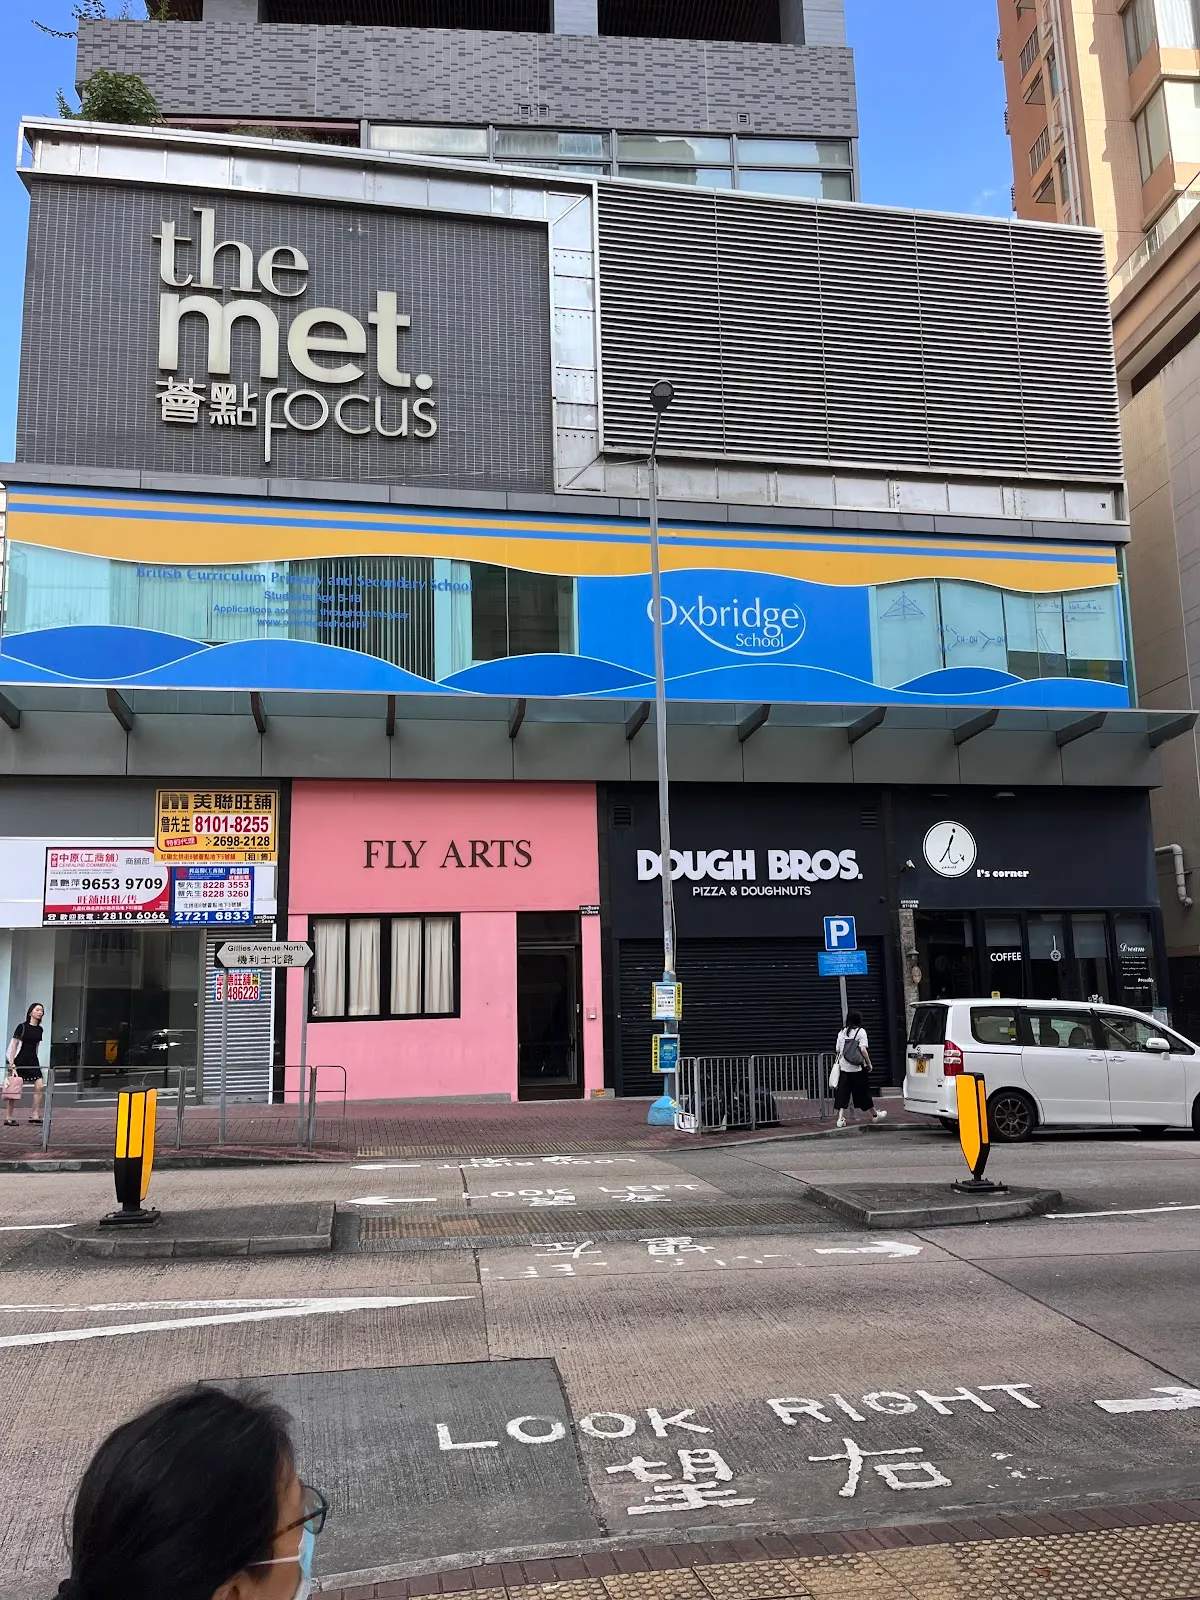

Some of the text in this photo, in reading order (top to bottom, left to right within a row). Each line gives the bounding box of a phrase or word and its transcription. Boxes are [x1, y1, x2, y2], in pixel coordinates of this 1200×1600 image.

[152, 207, 309, 297] the
[158, 290, 433, 391] met.
[156, 376, 438, 463] 薈點 focus
[136, 566, 182, 580] British
[187, 567, 266, 584] Curriculum
[431, 577, 472, 593] School
[646, 595, 800, 638] Oxbridge
[735, 632, 785, 648] School
[193, 793, 272, 810] 美聯旺舖
[195, 815, 269, 833] 8101-8255
[213, 836, 270, 847] 2698-2128
[363, 840, 533, 869] FLY ARTS
[636, 849, 864, 882] DOUGH BROS.
[992, 869, 1030, 878] corner
[81, 878, 120, 890] 9653
[125, 878, 163, 890] 9709
[202, 881, 225, 889] 8228
[227, 881, 249, 889] 3553
[692, 885, 812, 897] PIZZA & DOUGHNUTS
[202, 890, 225, 898] 8228
[227, 890, 249, 898] 3260
[102, 912, 133, 920] 2810
[136, 911, 167, 920] 6066
[174, 911, 209, 921] 2721
[215, 911, 250, 921] 6833
[828, 920, 850, 947] P
[283, 944, 304, 952] North
[990, 952, 1022, 962] COFFEE
[216, 986, 259, 1000] 5486228
[598, 1184, 700, 1193] LEFT
[437, 1382, 1042, 1451] LOOK RIGHT
